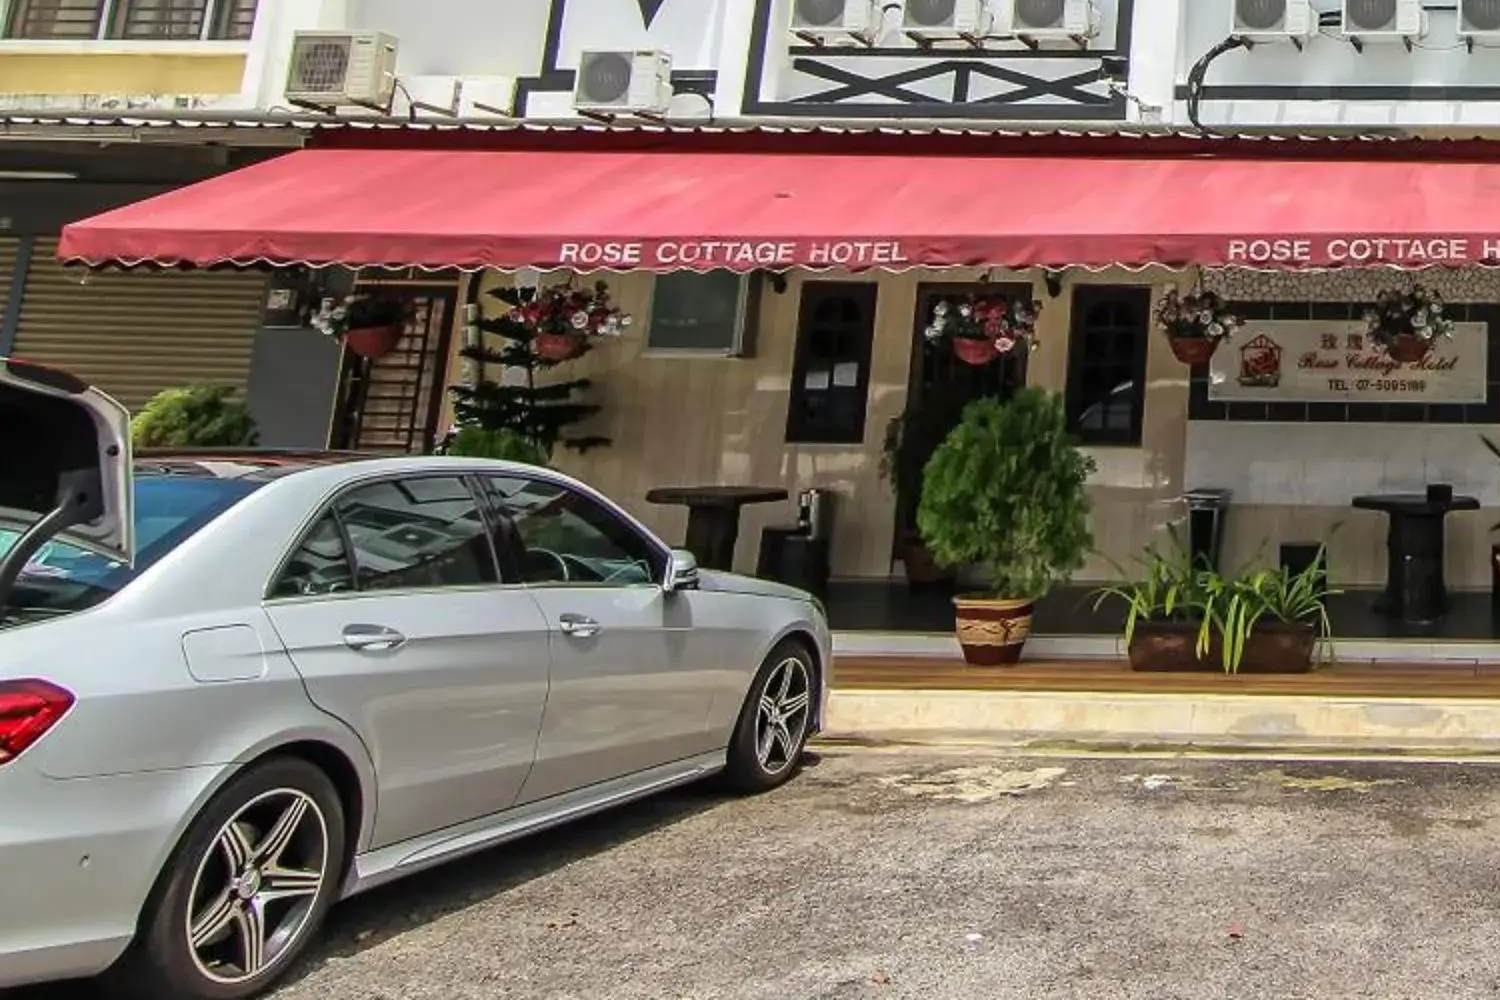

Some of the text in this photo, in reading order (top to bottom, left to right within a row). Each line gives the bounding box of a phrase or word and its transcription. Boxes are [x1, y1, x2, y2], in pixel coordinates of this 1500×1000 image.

[559, 241, 908, 264] ROSE COTTAGE HOTEL
[1227, 240, 1312, 262] ROSE
[1326, 239, 1468, 261] COTTAGE
[1297, 351, 1340, 369] Rose
